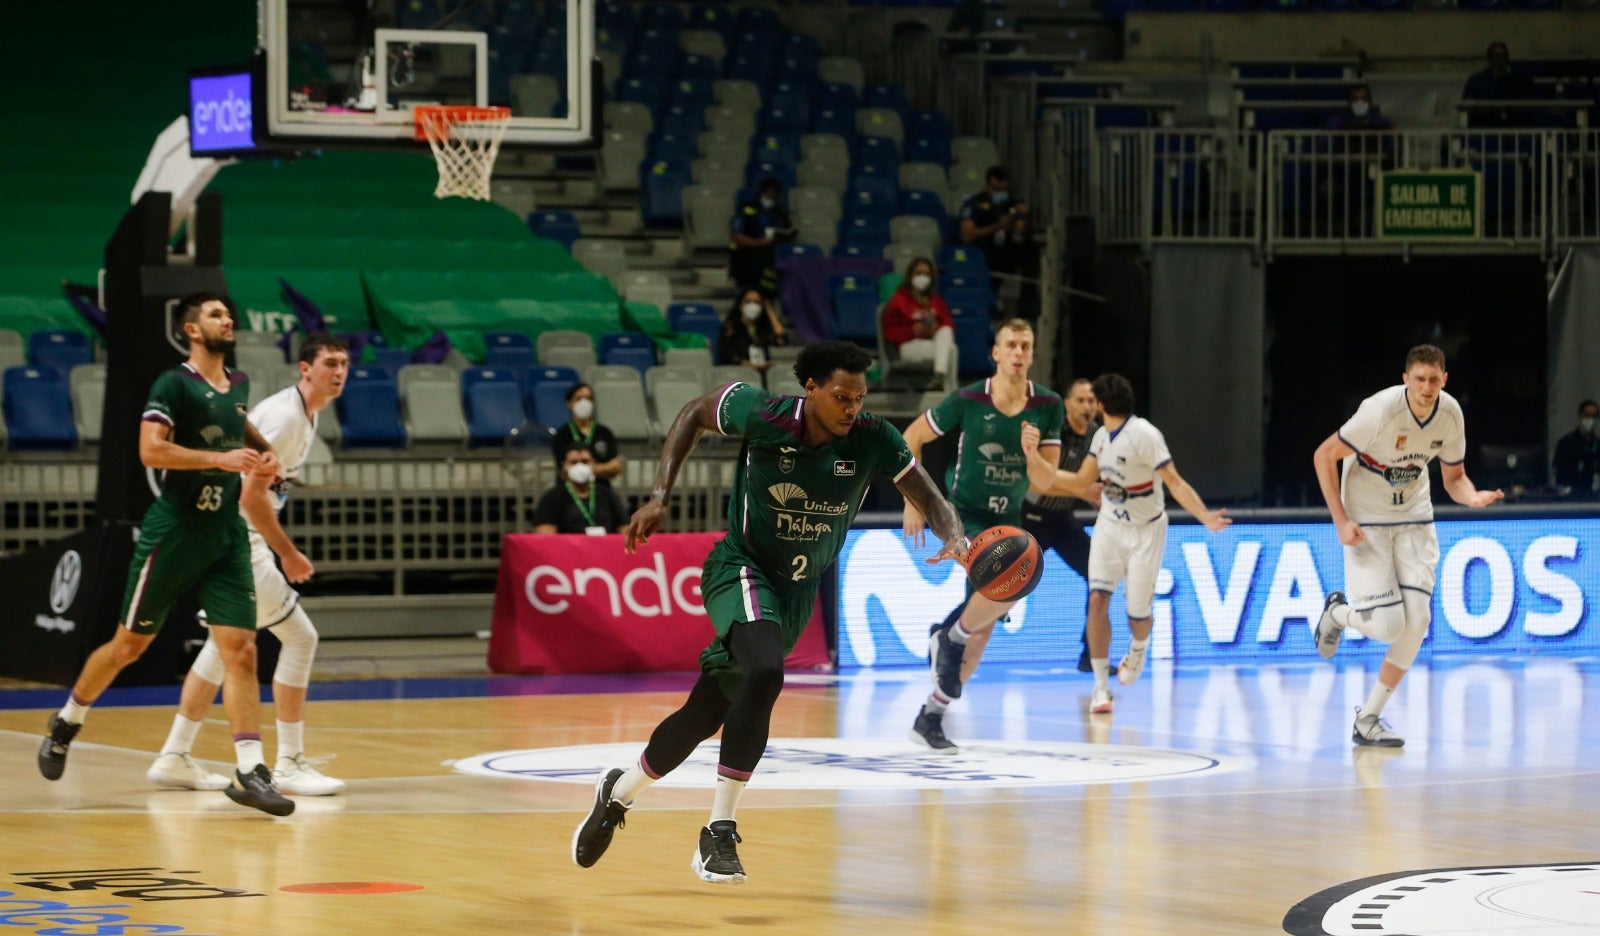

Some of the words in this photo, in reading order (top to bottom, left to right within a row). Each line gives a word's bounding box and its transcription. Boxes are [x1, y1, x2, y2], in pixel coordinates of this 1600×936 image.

[1390, 184, 1440, 205] SALIDA
[1449, 184, 1468, 205] DE
[1384, 208, 1472, 229] EMERGENCIA
[804, 500, 848, 514] Unicaja
[988, 496, 1009, 514] 52
[776, 513, 832, 540] Málaga
[791, 554, 808, 581] 2
[525, 552, 706, 617] ende
[1151, 535, 1586, 659] ¡VAOS
